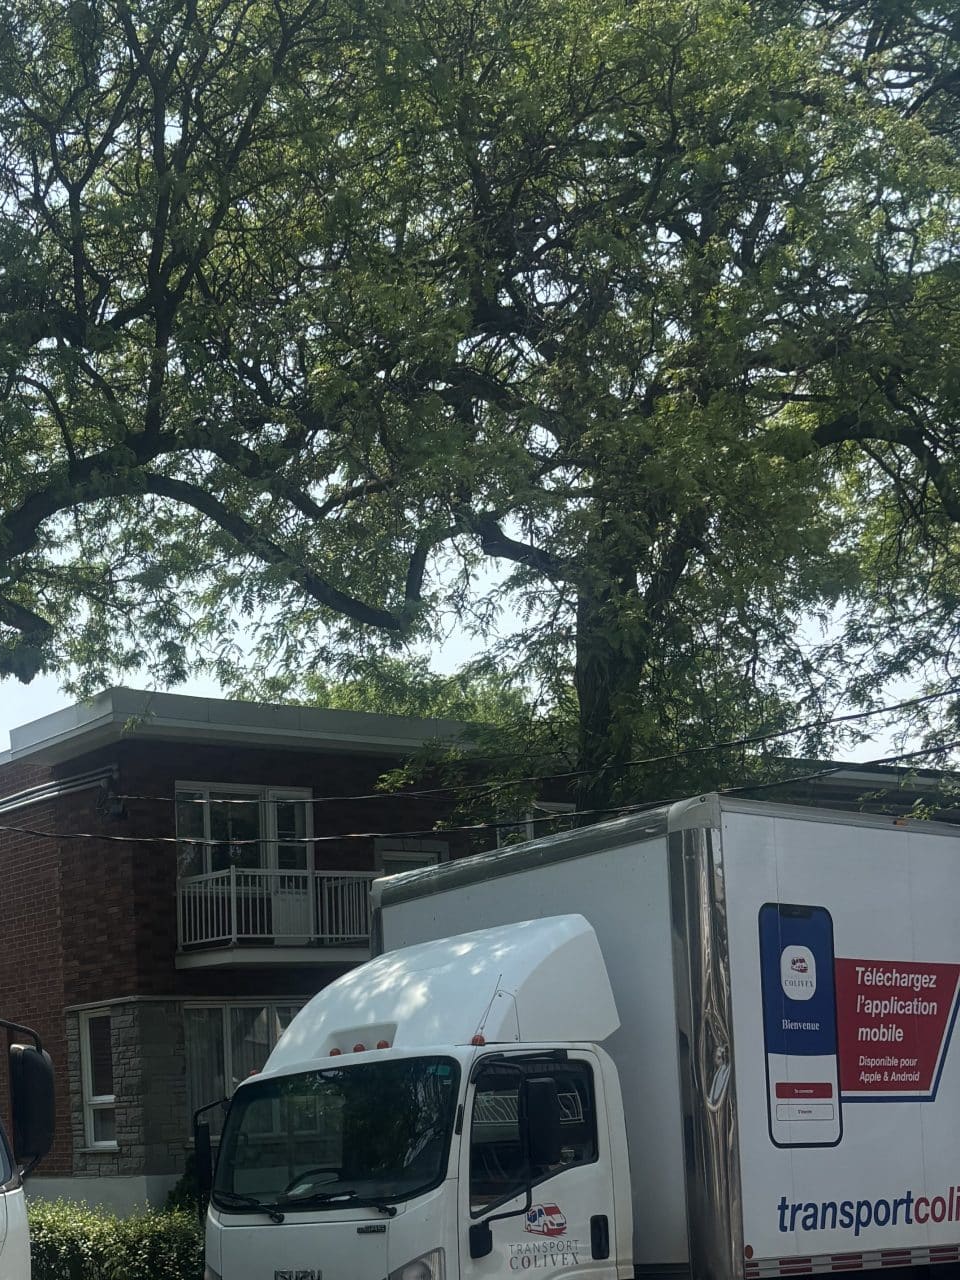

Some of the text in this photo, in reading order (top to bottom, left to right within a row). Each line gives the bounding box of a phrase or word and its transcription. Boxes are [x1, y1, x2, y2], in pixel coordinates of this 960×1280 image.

[855, 966, 937, 991] Téléchargez
[782, 1019, 820, 1031] Bienvenue
[858, 1023, 904, 1042] mobile
[859, 1055, 918, 1068] Disponible pour
[859, 1071, 920, 1084] Apple & Android
[508, 1240, 579, 1254] TRANSPORT
[509, 1252, 579, 1270] COLIVEX
